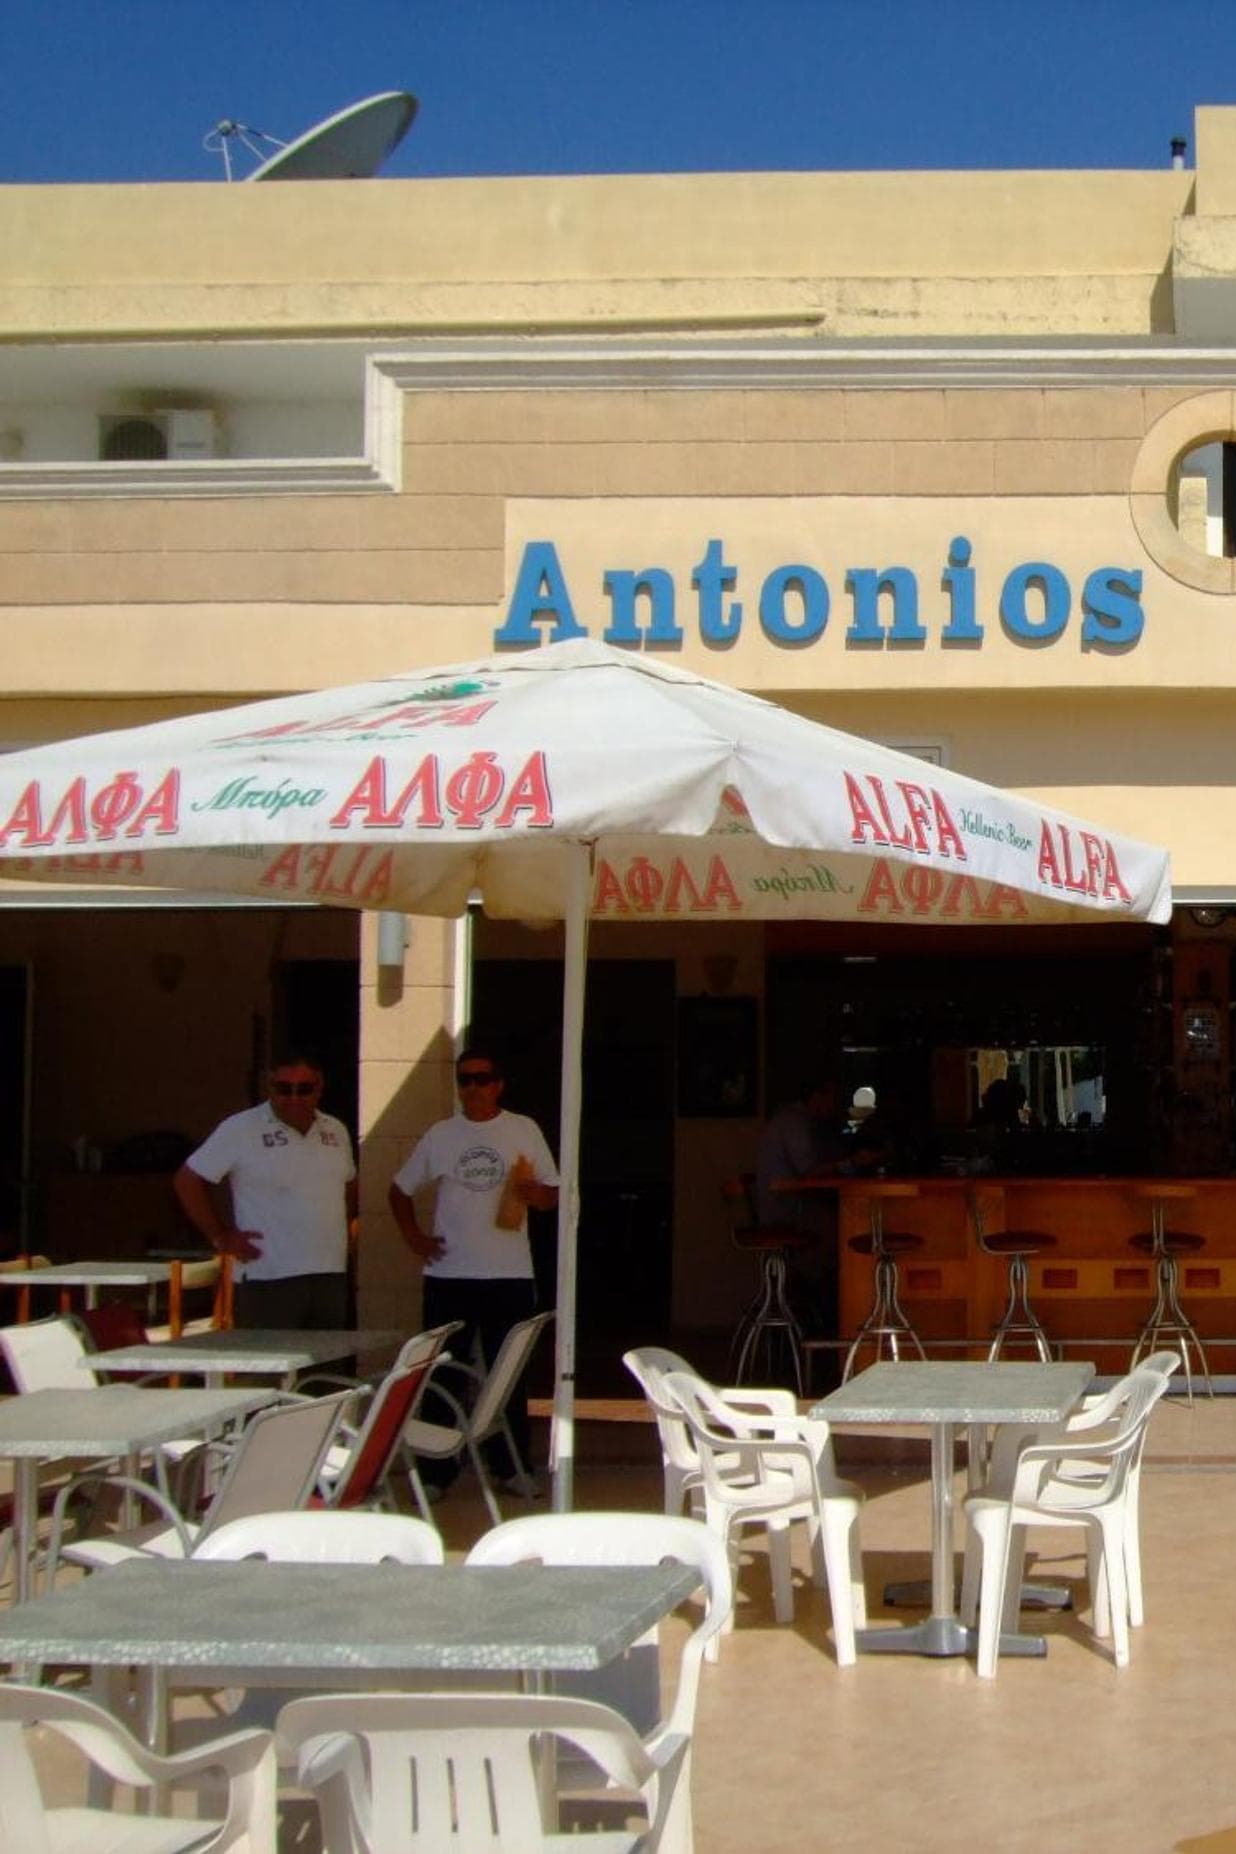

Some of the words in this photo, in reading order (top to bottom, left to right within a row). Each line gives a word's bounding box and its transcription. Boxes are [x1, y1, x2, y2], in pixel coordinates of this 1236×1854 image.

[493, 536, 1146, 650] Antonios
[0, 767, 181, 847] ΑΛΦΑ
[329, 750, 554, 828] ΑΛΦΑ
[842, 770, 967, 862] ALFA
[1036, 816, 1131, 905] ALFA
